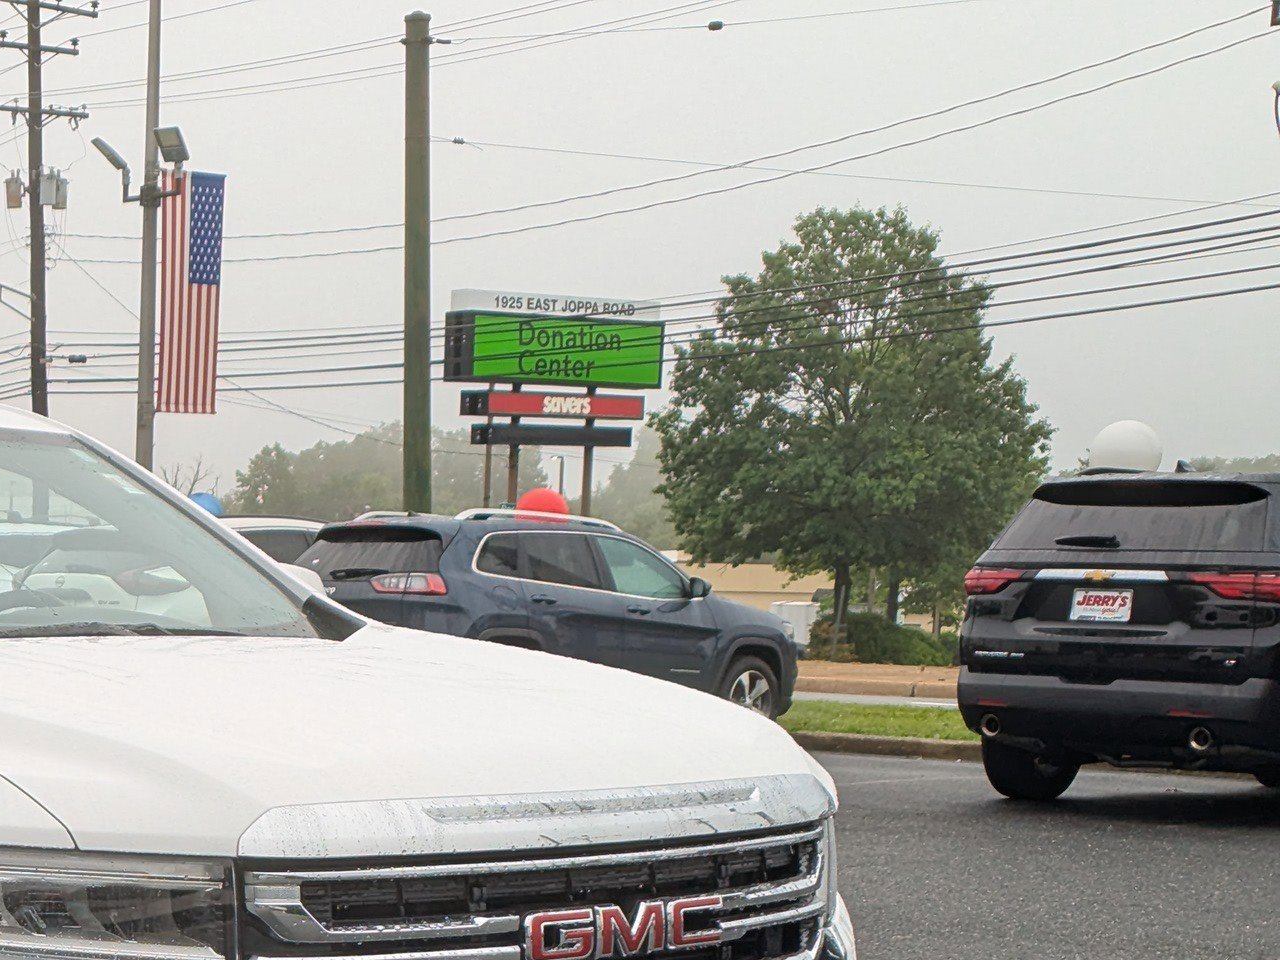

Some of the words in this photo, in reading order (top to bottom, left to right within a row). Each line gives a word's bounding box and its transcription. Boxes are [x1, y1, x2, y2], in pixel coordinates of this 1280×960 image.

[495, 294, 523, 309] 1925
[527, 297, 558, 312] EAST
[561, 300, 599, 314] JOPPA
[602, 302, 636, 316] ROAD
[518, 320, 622, 352] Donation
[518, 349, 596, 379] Center
[1076, 594, 1129, 608] JERRY'S
